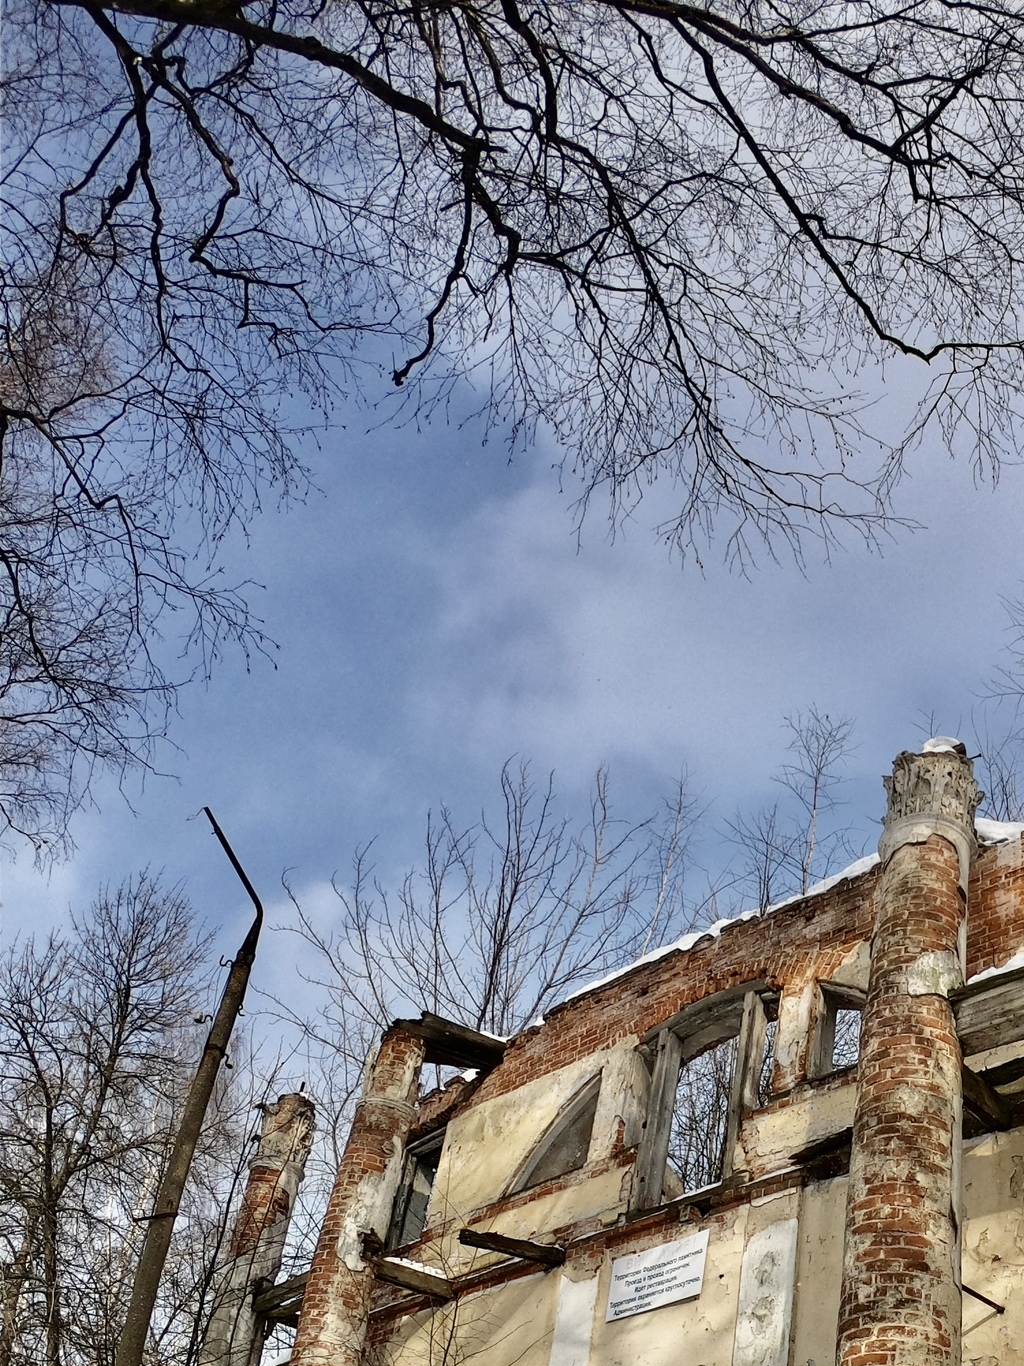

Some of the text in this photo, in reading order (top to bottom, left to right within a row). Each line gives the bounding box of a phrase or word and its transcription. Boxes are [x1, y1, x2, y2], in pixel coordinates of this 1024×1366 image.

[615, 1249, 703, 1282] Территория Федерального памятника
[625, 1278, 642, 1288] Проезд
[610, 1297, 636, 1309] Территория
[637, 1288, 664, 1301] охраняется
